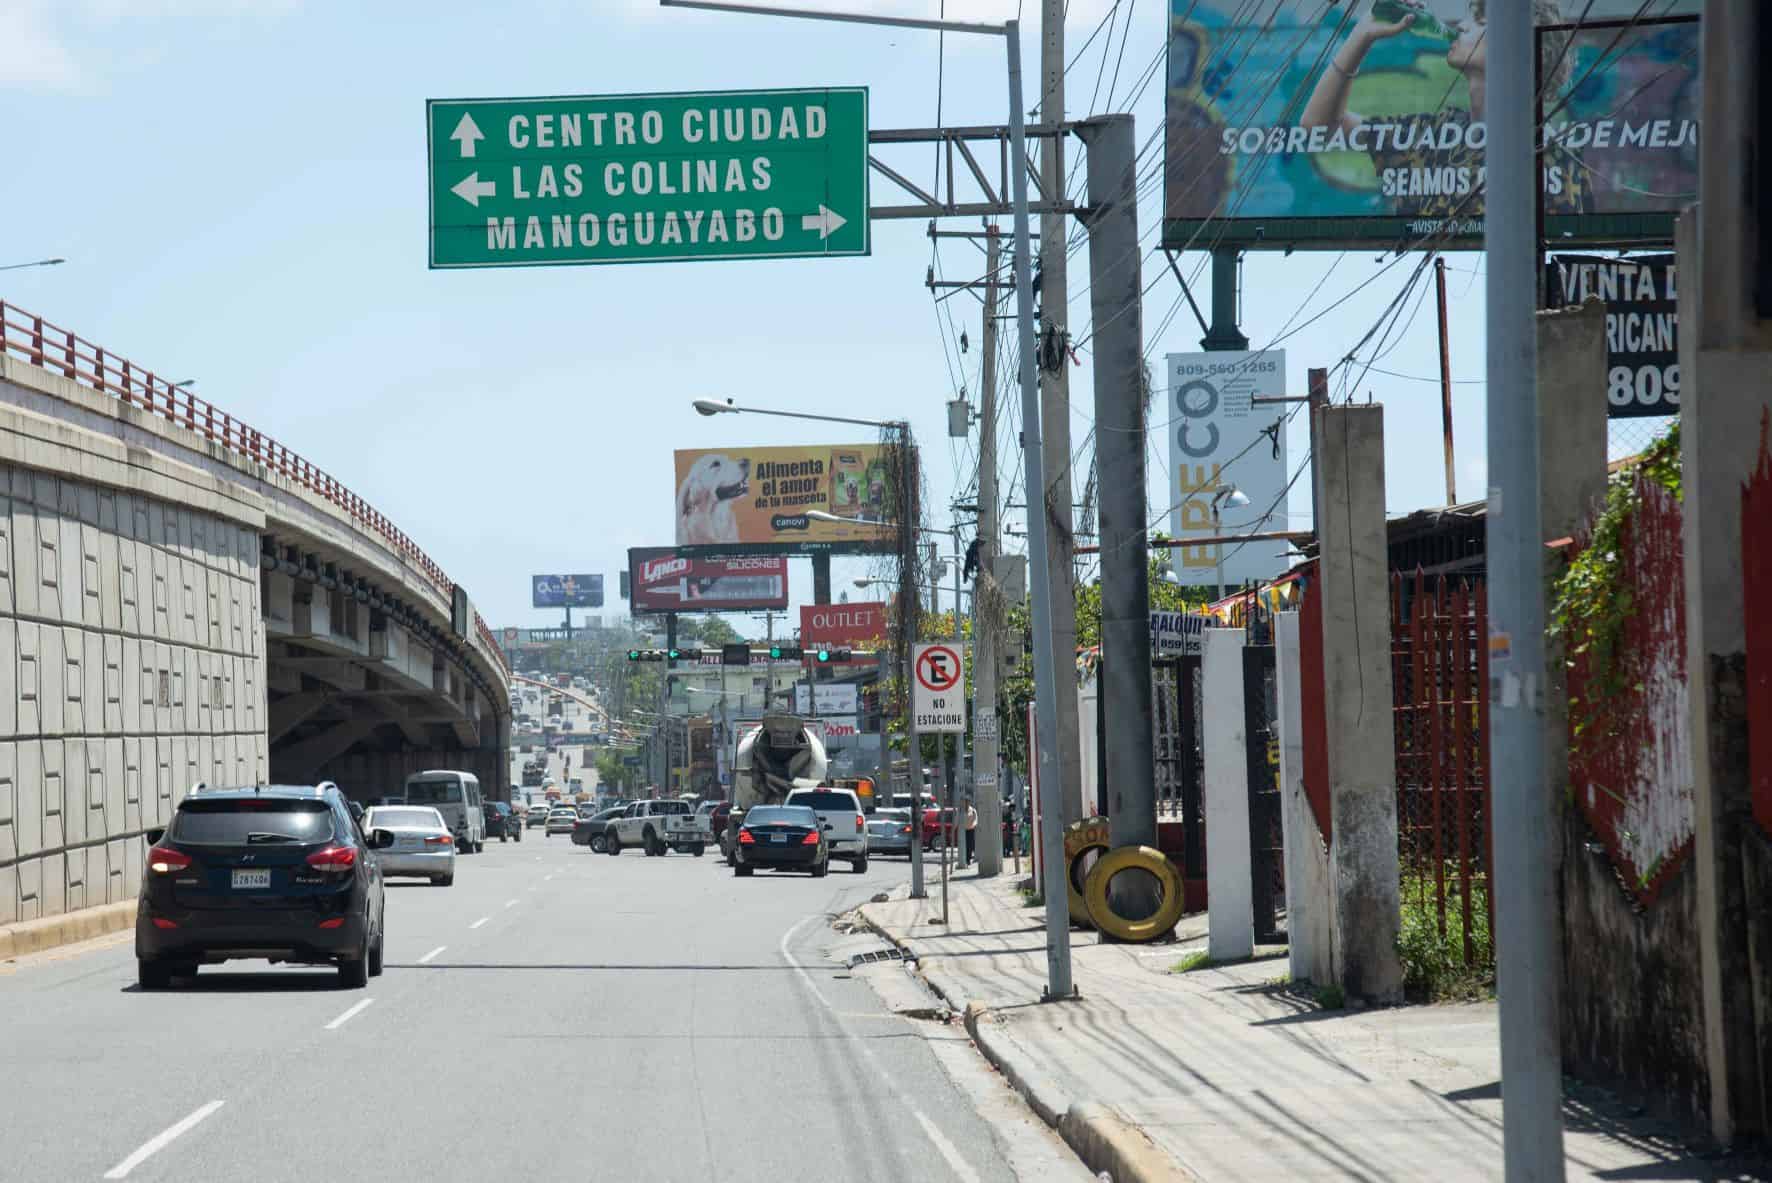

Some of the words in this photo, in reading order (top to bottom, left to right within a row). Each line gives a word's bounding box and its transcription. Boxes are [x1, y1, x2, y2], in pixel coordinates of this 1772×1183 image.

[508, 111, 664, 149] CENTRO
[682, 105, 827, 142] CIUDAD
[512, 164, 583, 199] LAS
[604, 157, 772, 196] COLINAS
[1382, 167, 1470, 196] SEAMOS
[487, 207, 785, 249] MANOGUAYABO
[1558, 263, 1657, 301] VENTA
[756, 459, 824, 480] Alimenta
[762, 479, 776, 497] el
[780, 477, 819, 495] amor
[755, 496, 767, 509] de
[770, 494, 781, 507] tu
[782, 491, 827, 507] mascota
[813, 611, 874, 629] OUTLET
[933, 698, 945, 709] NO
[917, 715, 962, 726] ESTACIONE
